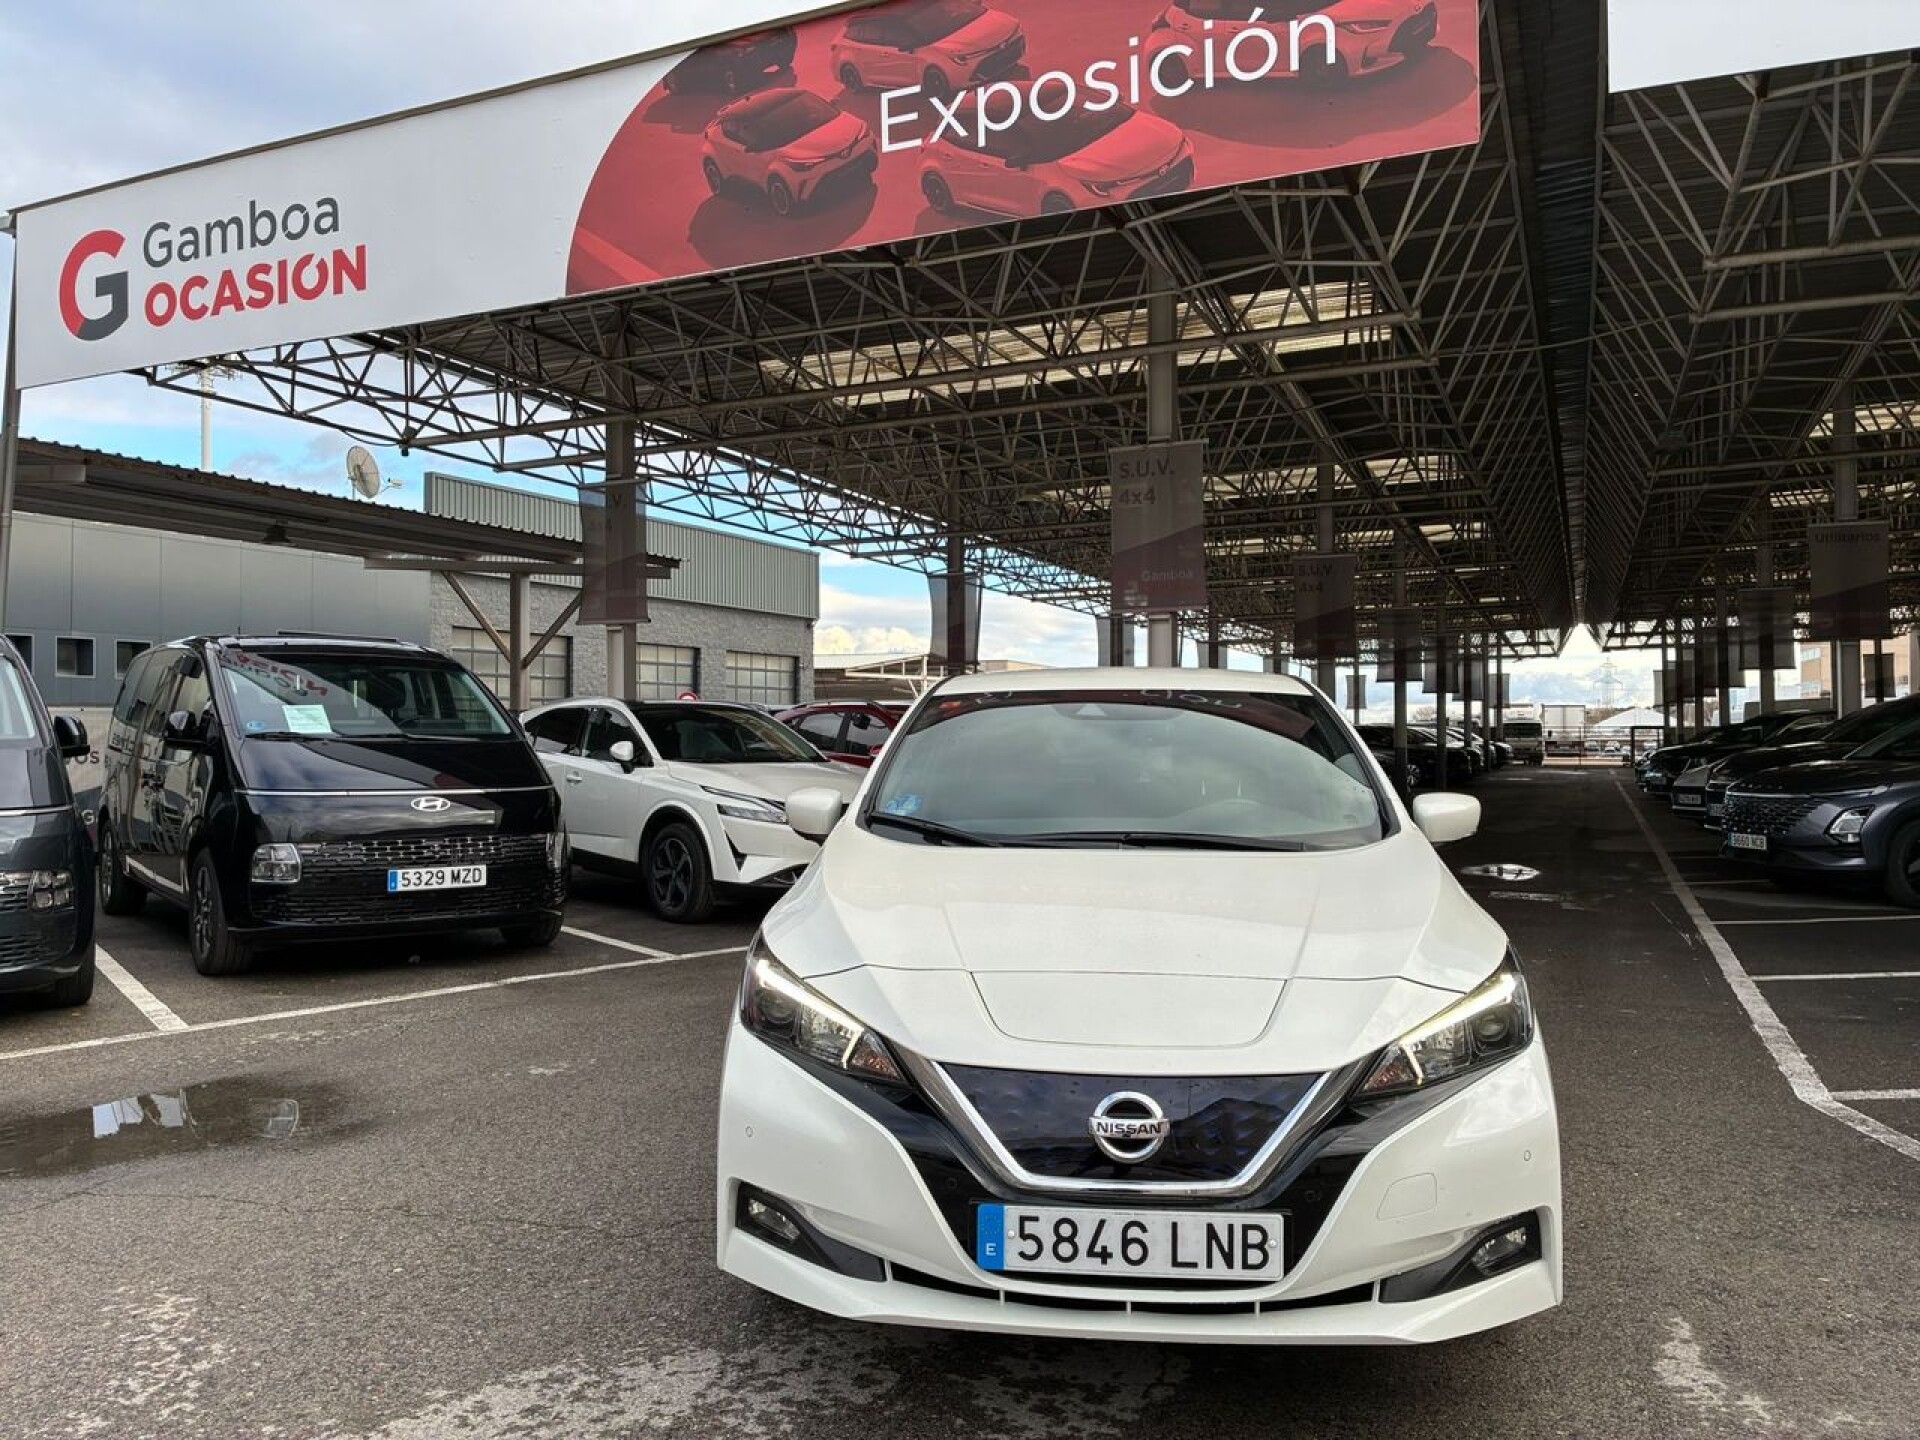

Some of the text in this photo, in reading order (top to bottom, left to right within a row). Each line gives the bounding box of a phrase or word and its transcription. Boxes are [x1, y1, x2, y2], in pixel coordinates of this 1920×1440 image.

[880, 7, 1336, 154] Exposición
[143, 196, 340, 268] Gamboa
[1118, 457, 1176, 479] S.U.V.
[1117, 488, 1156, 505] 4x4
[401, 867, 482, 887] 5329 MZD
[1097, 1122, 1162, 1135] NISSAN
[1018, 1216, 1270, 1270] 5846 LNB
